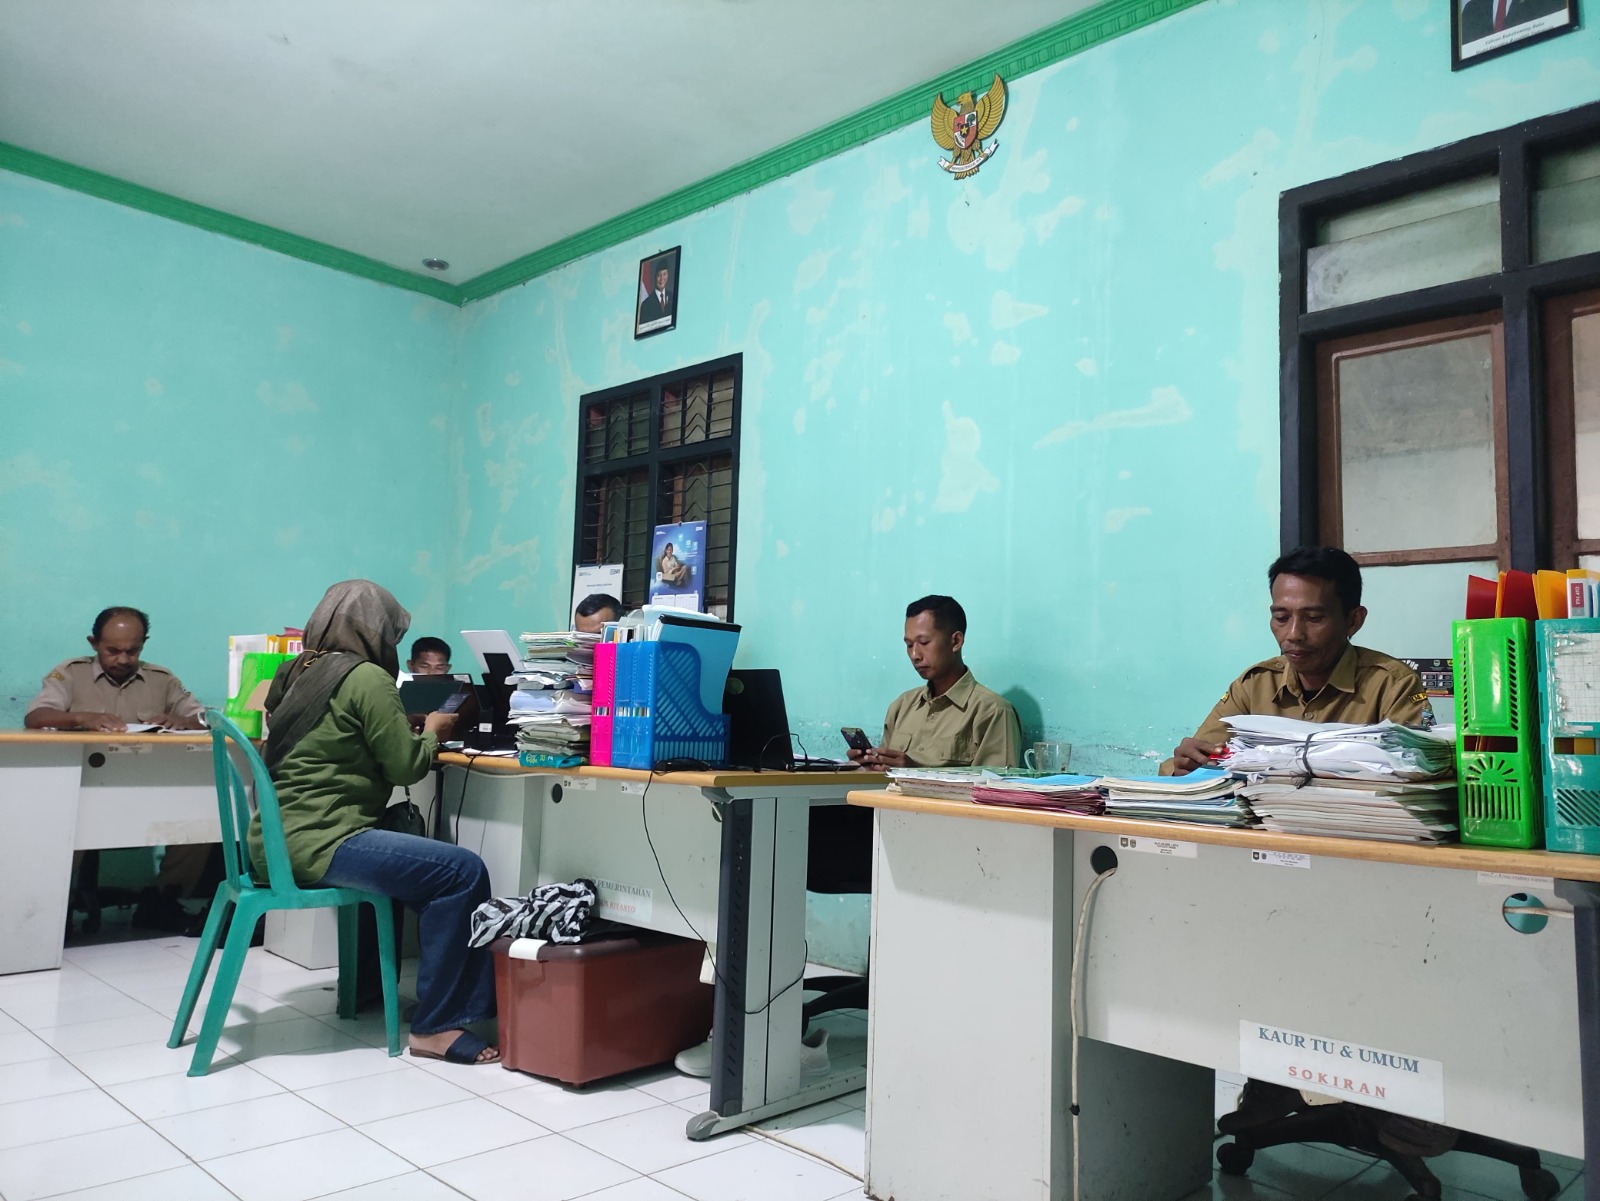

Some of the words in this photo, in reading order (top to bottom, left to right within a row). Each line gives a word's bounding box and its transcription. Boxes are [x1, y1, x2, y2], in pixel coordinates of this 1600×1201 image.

[597, 880, 652, 898] PEMERINTAHAN
[1258, 1026, 1306, 1049] KAUR
[1310, 1038, 1335, 1055] TU
[1339, 1045, 1353, 1059] &
[1358, 1048, 1420, 1074] UMUM
[1288, 1066, 1386, 1098] SOKIRAN
